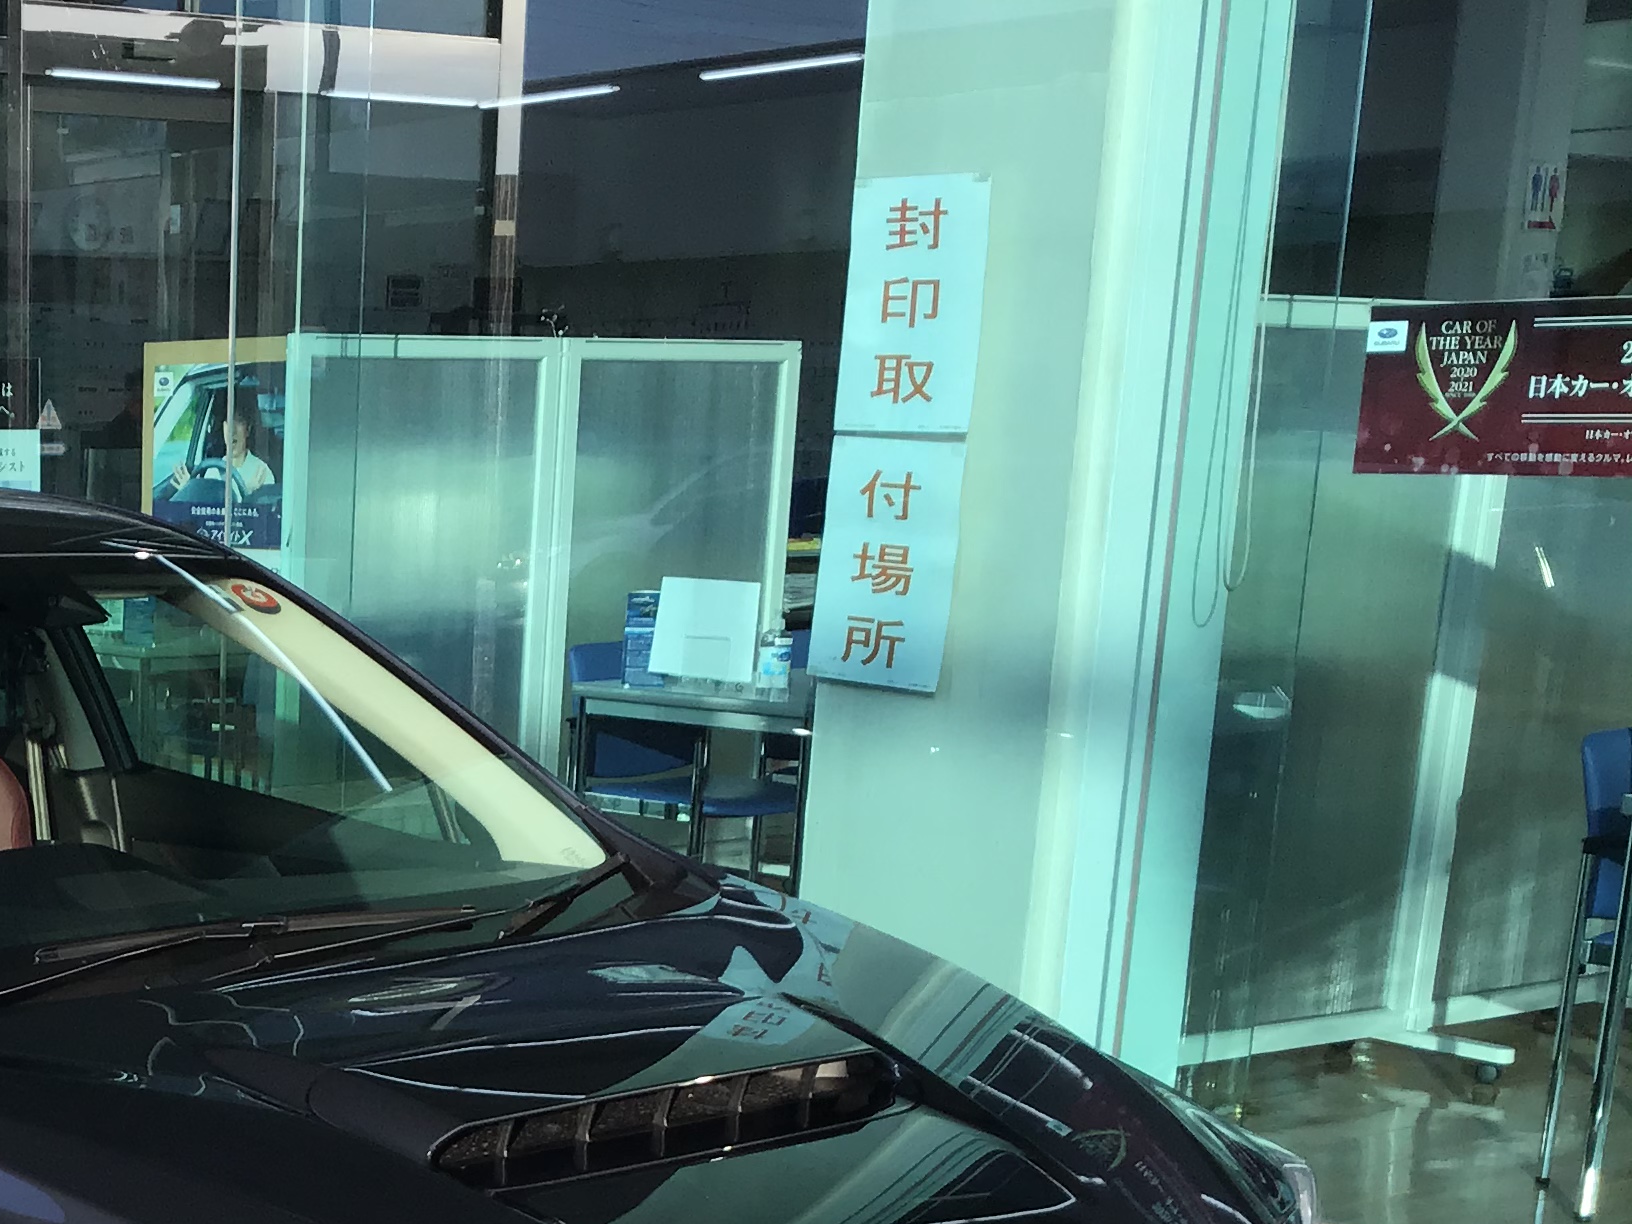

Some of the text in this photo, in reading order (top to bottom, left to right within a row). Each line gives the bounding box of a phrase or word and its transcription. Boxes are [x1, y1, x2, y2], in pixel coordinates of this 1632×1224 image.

[1441, 319, 1497, 334] CAR OF
[1429, 336, 1503, 350] THE YEAR
[1440, 350, 1487, 367] JAPAN
[1450, 366, 1477, 378] 2020
[1448, 381, 1473, 392] 2021
